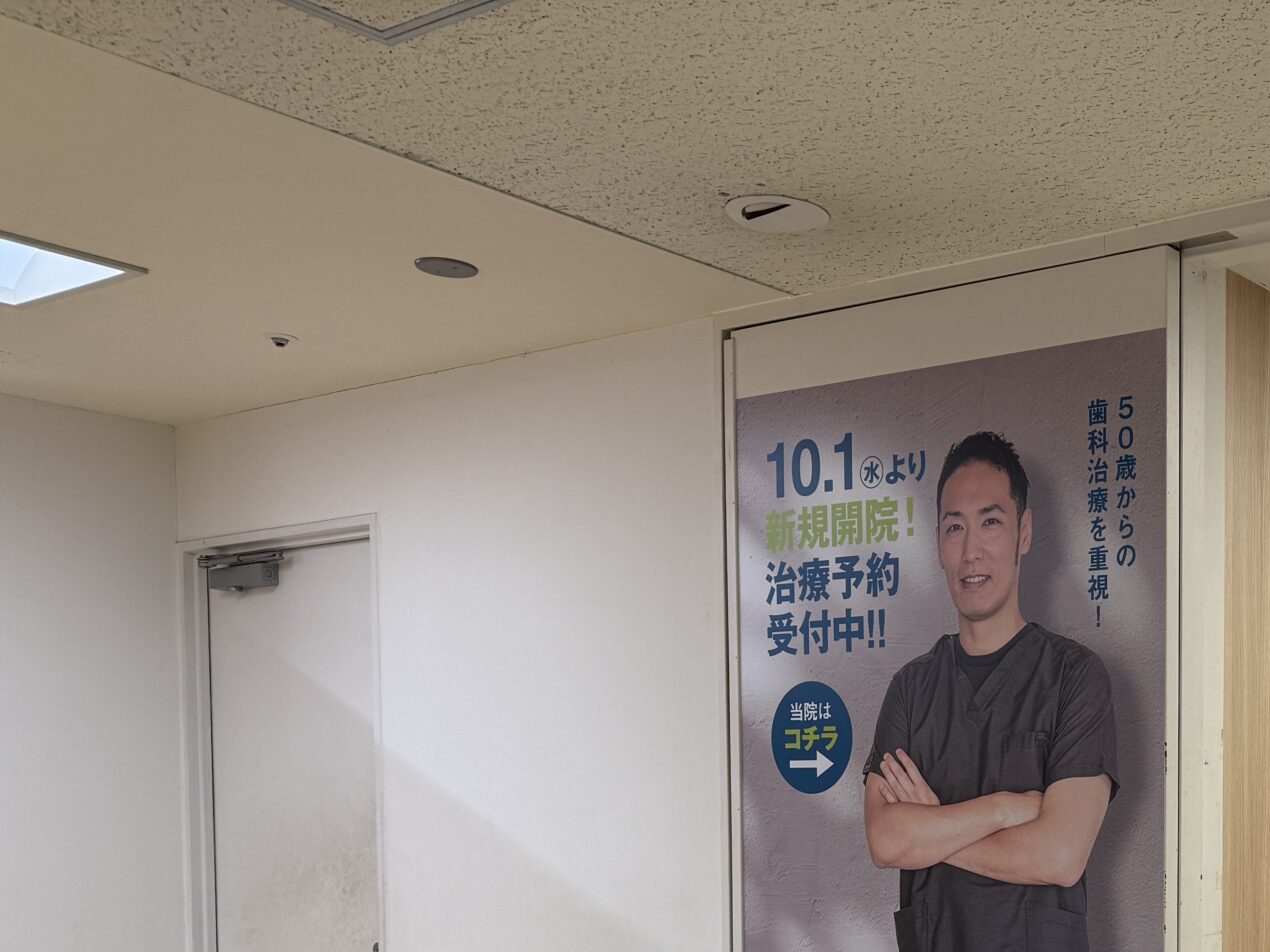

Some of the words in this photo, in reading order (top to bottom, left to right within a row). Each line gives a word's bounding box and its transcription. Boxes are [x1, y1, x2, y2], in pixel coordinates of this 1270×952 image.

[765, 496, 915, 553] 新規開院!
[766, 552, 900, 604] 治療予約
[767, 609, 886, 656] 受付中!!
[790, 702, 831, 721] 当院は
[784, 725, 839, 751] コチラ
